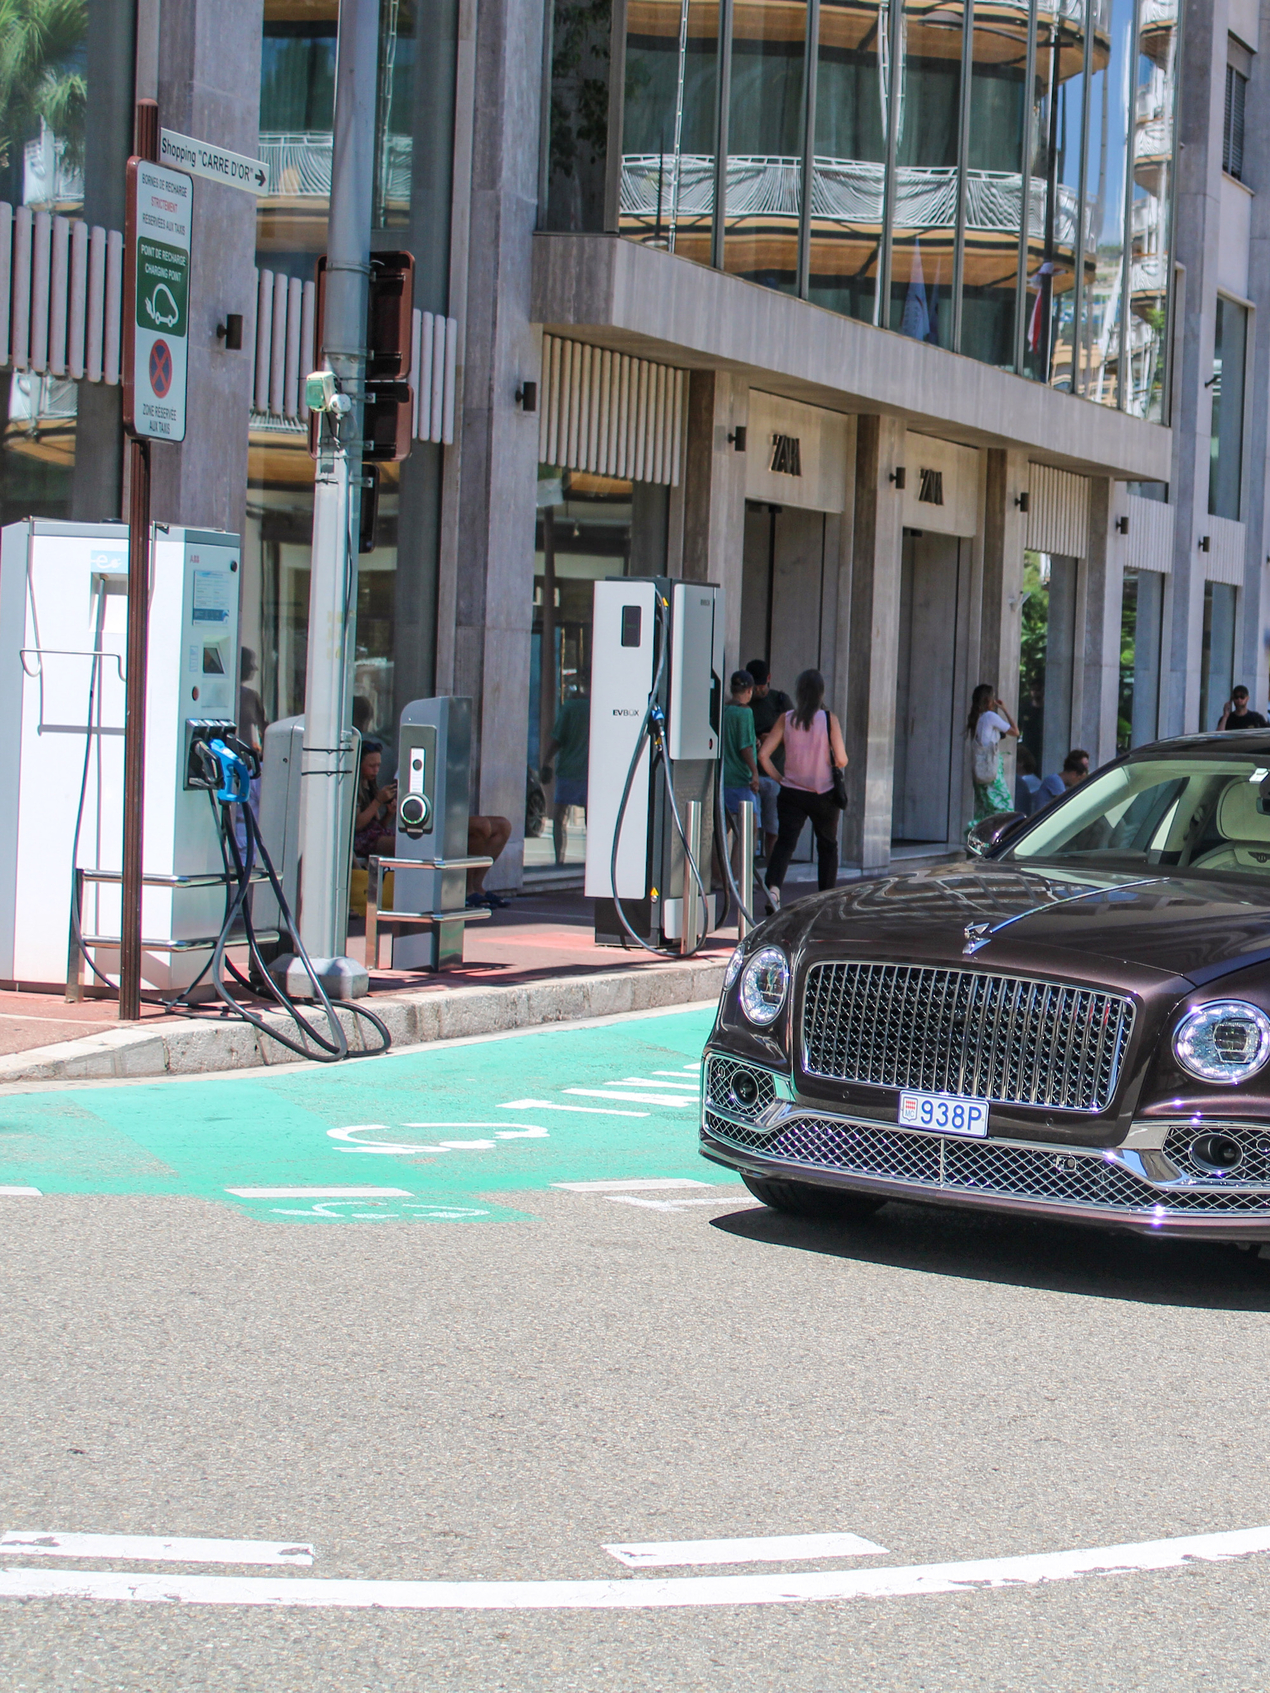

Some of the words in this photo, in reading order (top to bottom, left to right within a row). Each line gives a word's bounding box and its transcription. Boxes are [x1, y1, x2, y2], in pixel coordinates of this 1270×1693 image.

[162, 137, 196, 168] Shopping
[199, 150, 229, 175] "CARRE
[231, 161, 254, 182] D'OR"
[142, 173, 159, 189] BORNES
[159, 179, 165, 191] DE
[165, 181, 187, 198] RECHARGE
[151, 196, 178, 213] STRICTEMENT
[166, 219, 174, 232] AUX
[174, 222, 186, 236] TAXIS
[141, 244, 155, 257] POINT
[155, 247, 162, 260] DE
[162, 249, 186, 267] RECHARGE
[145, 263, 169, 279] CHARGING
[168, 269, 182, 282] POINT
[143, 403, 155, 417] ZONE
[149, 420, 158, 432] AUX
[158, 421, 170, 434] TAXIS
[769, 433, 803, 477] ZARA
[918, 467, 945, 506] ZARA
[612, 709, 639, 717] EVBOX
[920, 1099, 982, 1131] 938P
